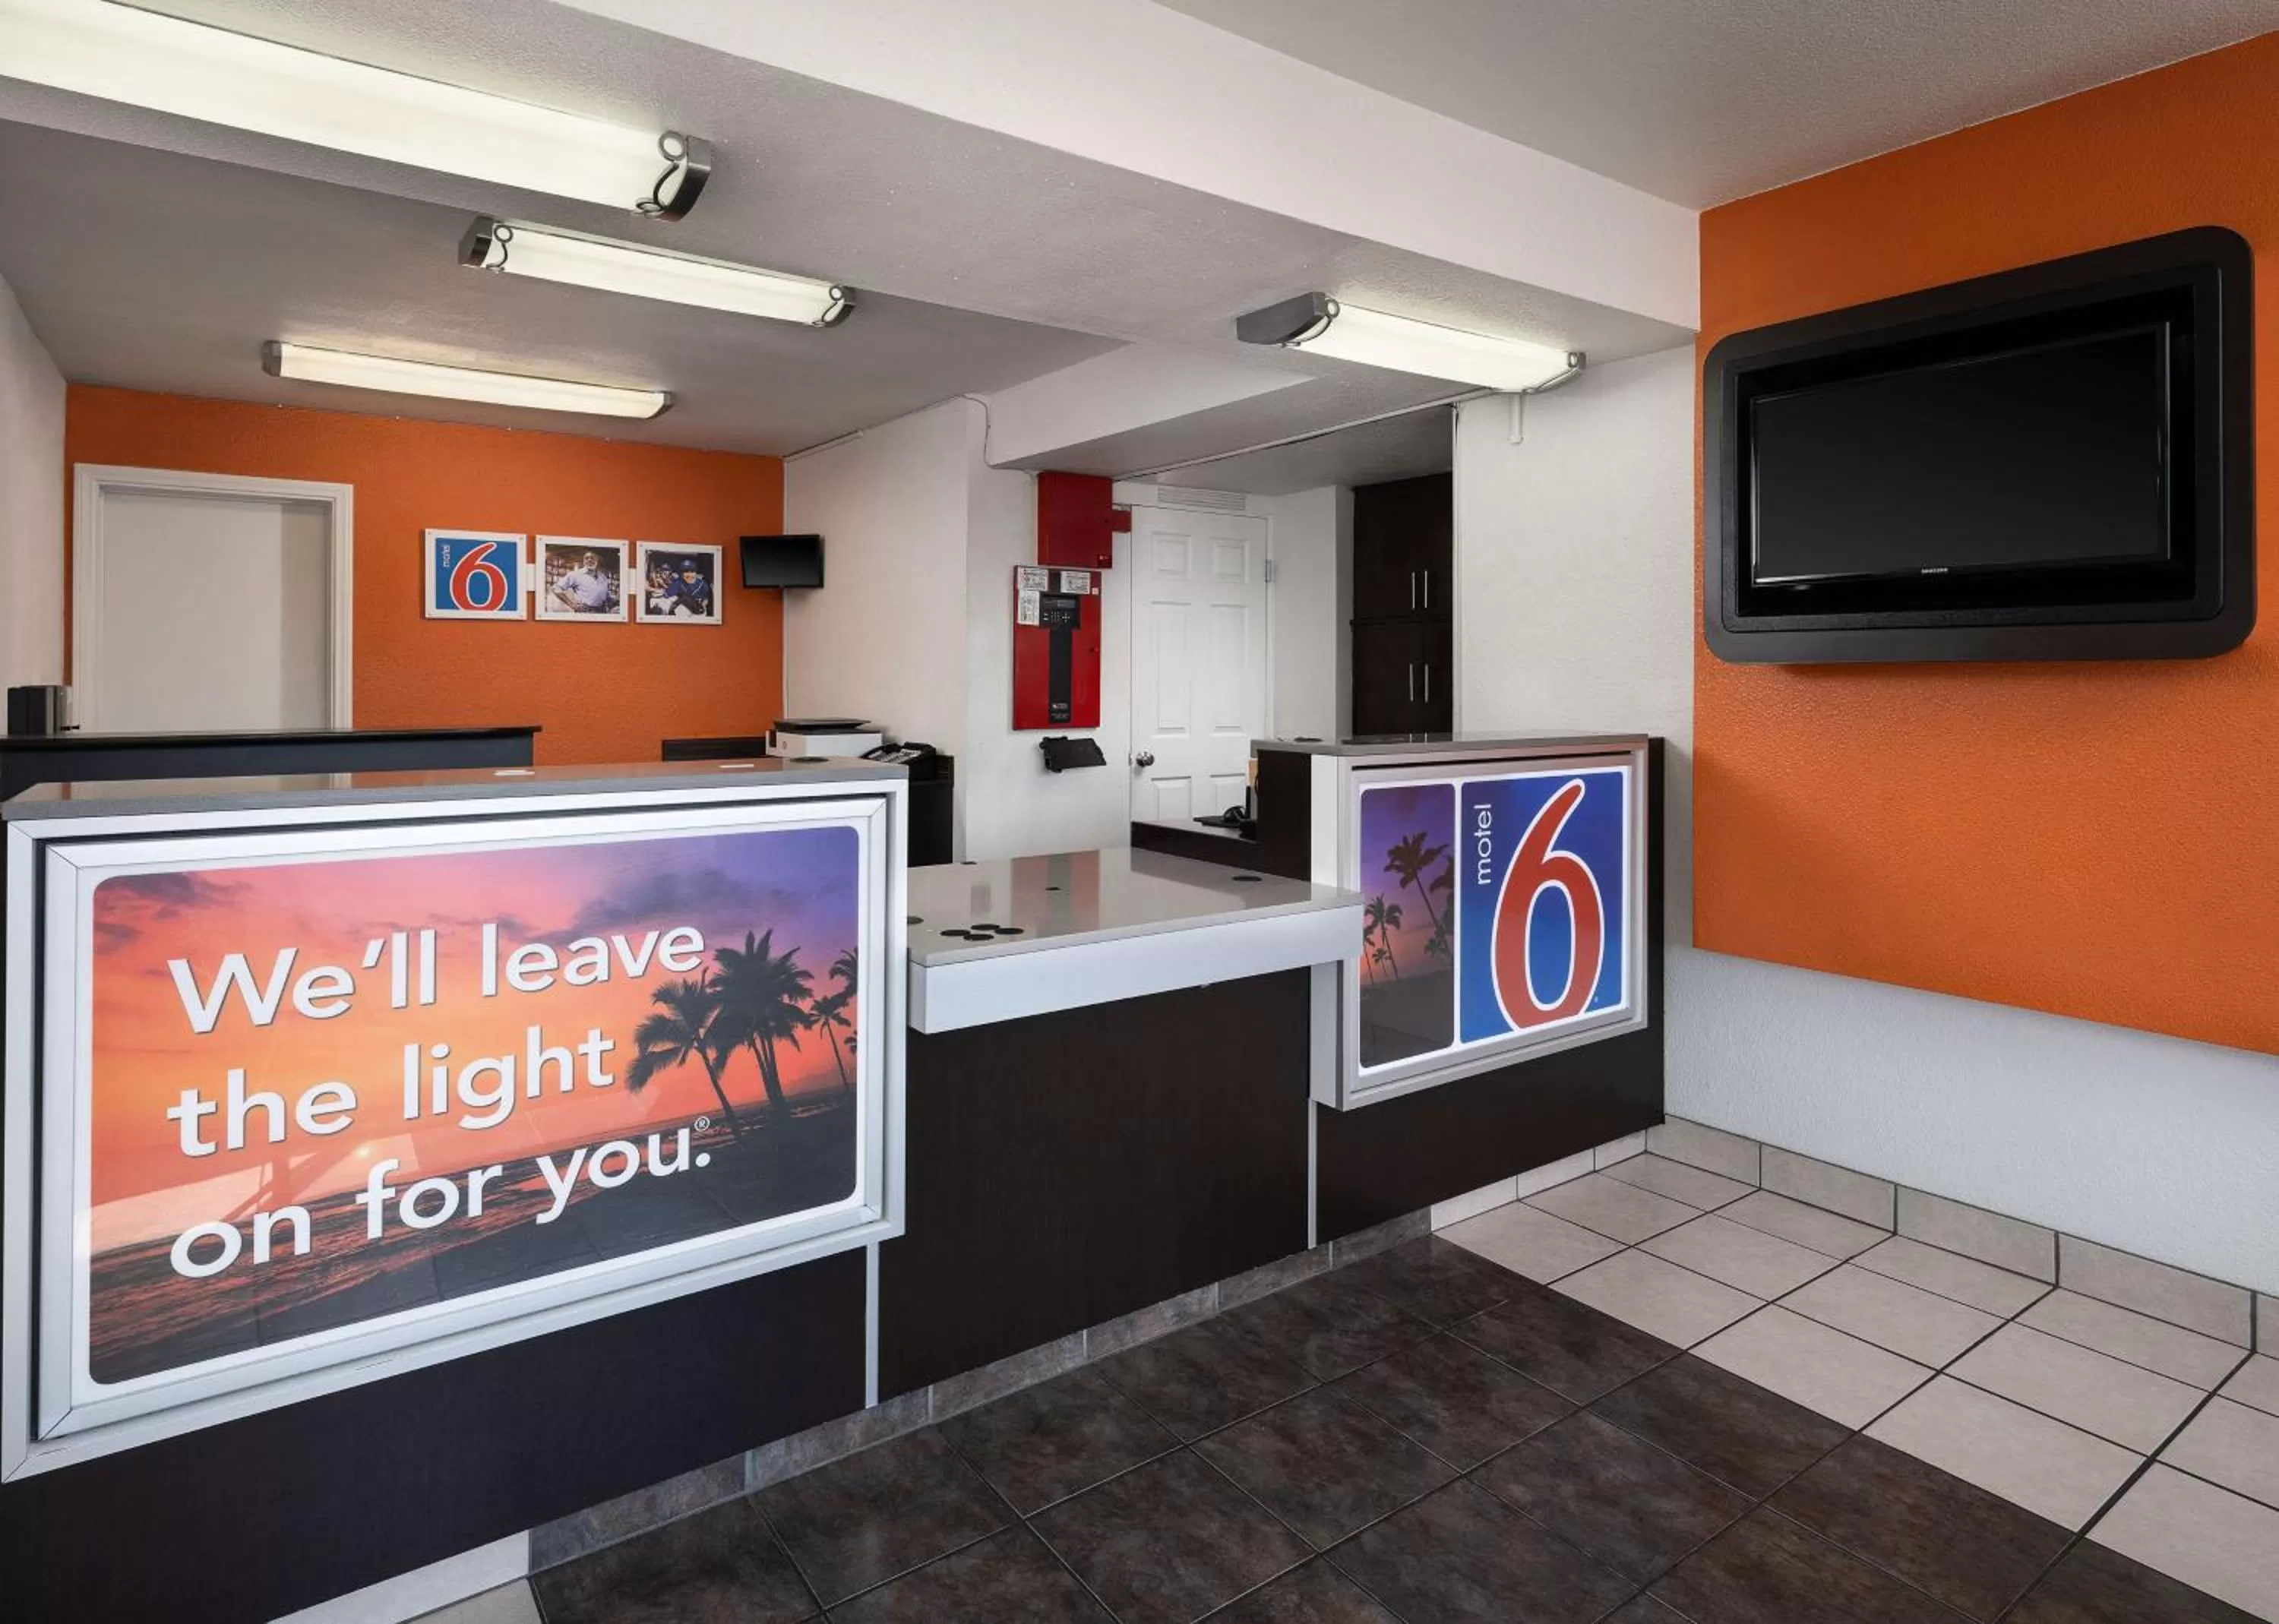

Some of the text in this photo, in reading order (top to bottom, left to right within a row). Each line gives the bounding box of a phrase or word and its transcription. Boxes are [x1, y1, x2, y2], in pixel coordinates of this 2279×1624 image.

[450, 542, 507, 612] 6
[1473, 779, 1604, 1032] motel 6
[167, 924, 705, 1035] We'll leave
[166, 1025, 615, 1157] the light
[169, 1204, 311, 1278] on
[355, 1158, 504, 1240] for
